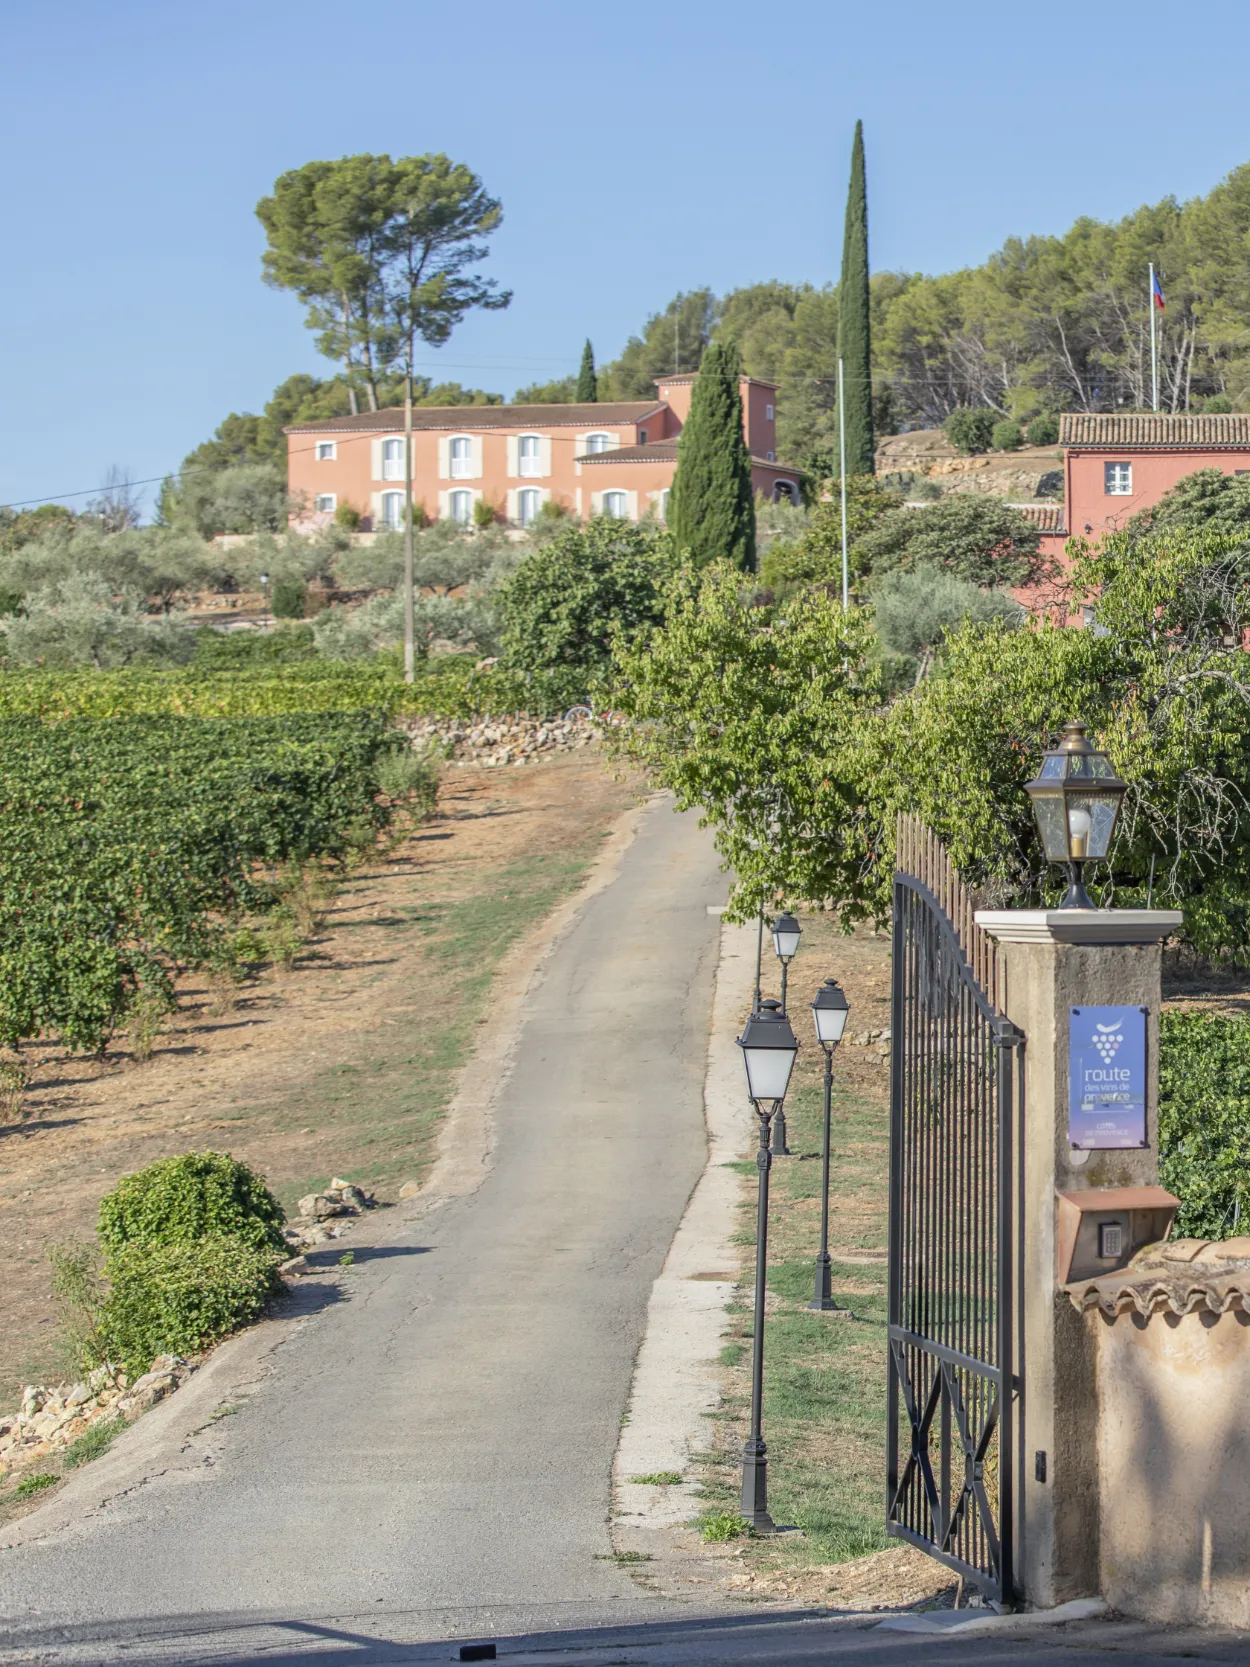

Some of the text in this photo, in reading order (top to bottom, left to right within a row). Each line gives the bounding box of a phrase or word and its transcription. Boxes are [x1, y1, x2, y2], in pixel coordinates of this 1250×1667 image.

[1085, 1067, 1130, 1081] route
[1085, 1082, 1130, 1091] des vins de
